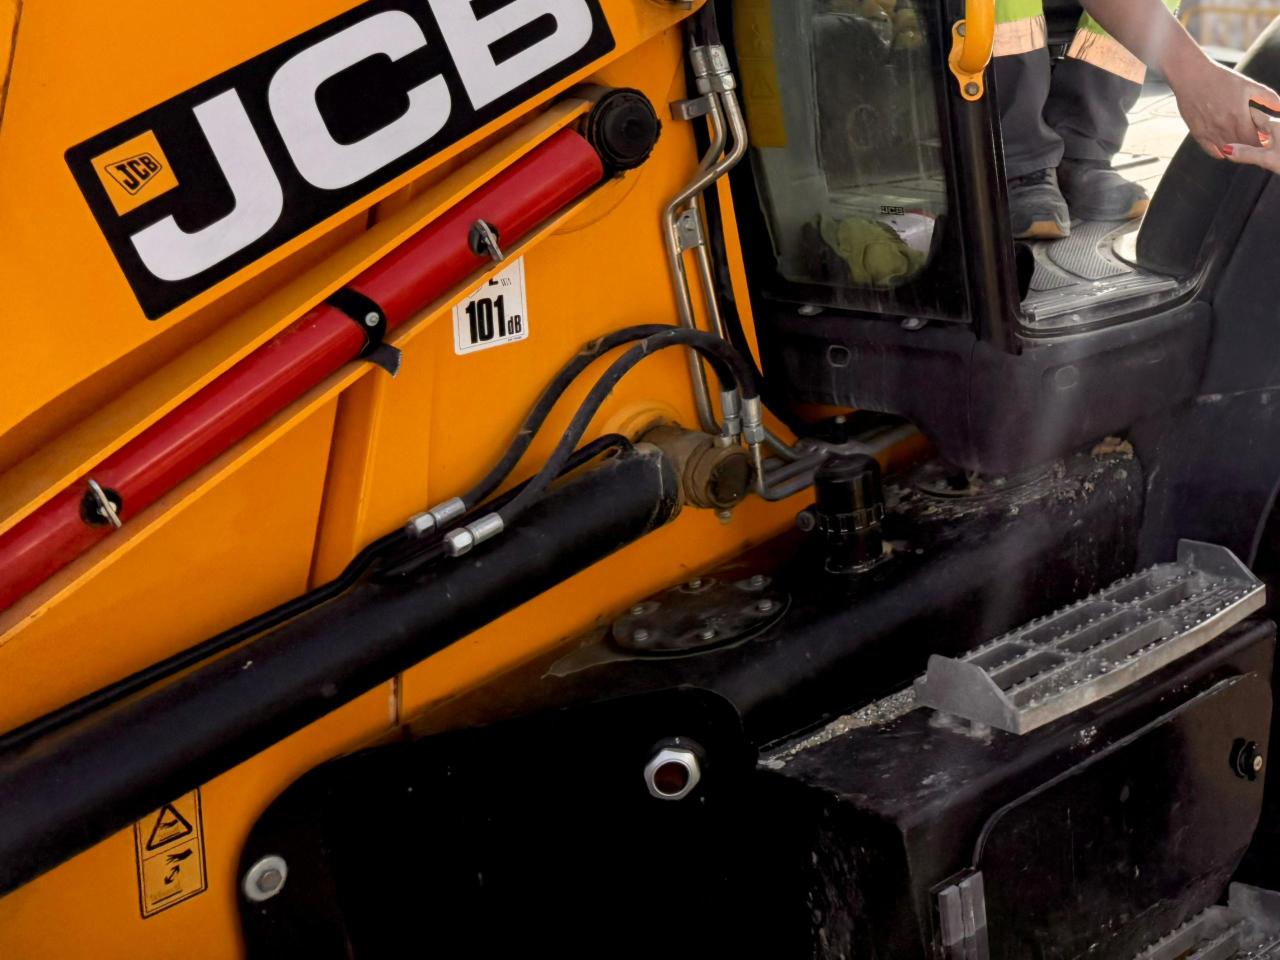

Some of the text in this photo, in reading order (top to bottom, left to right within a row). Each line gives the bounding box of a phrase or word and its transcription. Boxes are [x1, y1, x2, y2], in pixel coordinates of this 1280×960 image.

[115, 155, 159, 190] JCB
[466, 295, 522, 344] 101 dB
